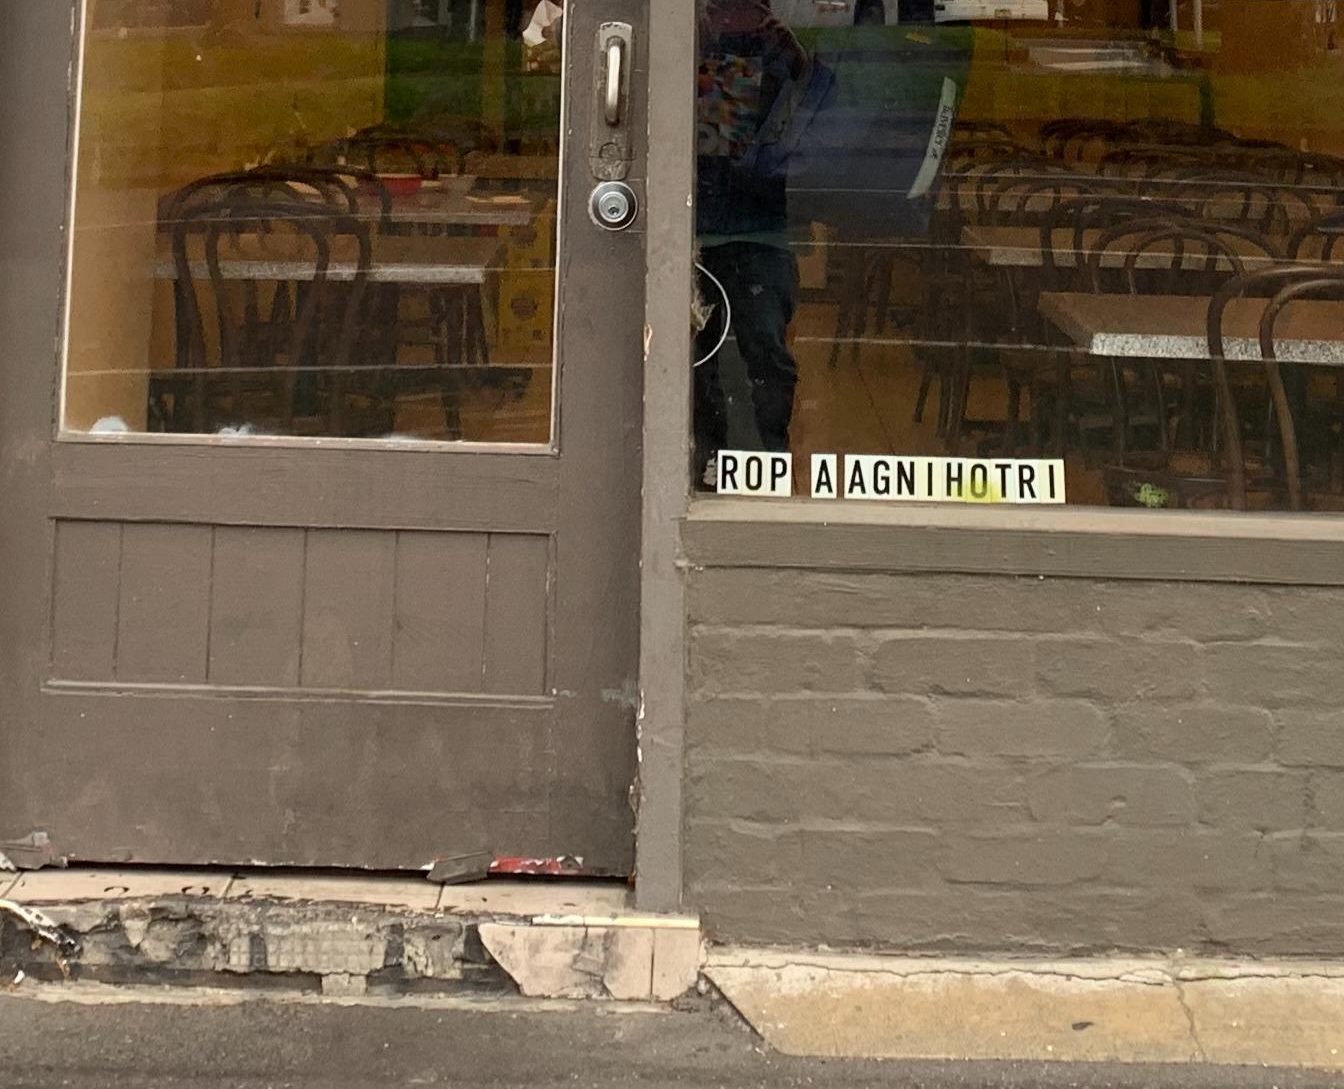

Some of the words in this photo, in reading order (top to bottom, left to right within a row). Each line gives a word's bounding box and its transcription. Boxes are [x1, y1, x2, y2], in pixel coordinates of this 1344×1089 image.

[721, 454, 788, 491] ROP
[815, 460, 833, 494] A
[848, 459, 1056, 500] AGNIHOTRI
